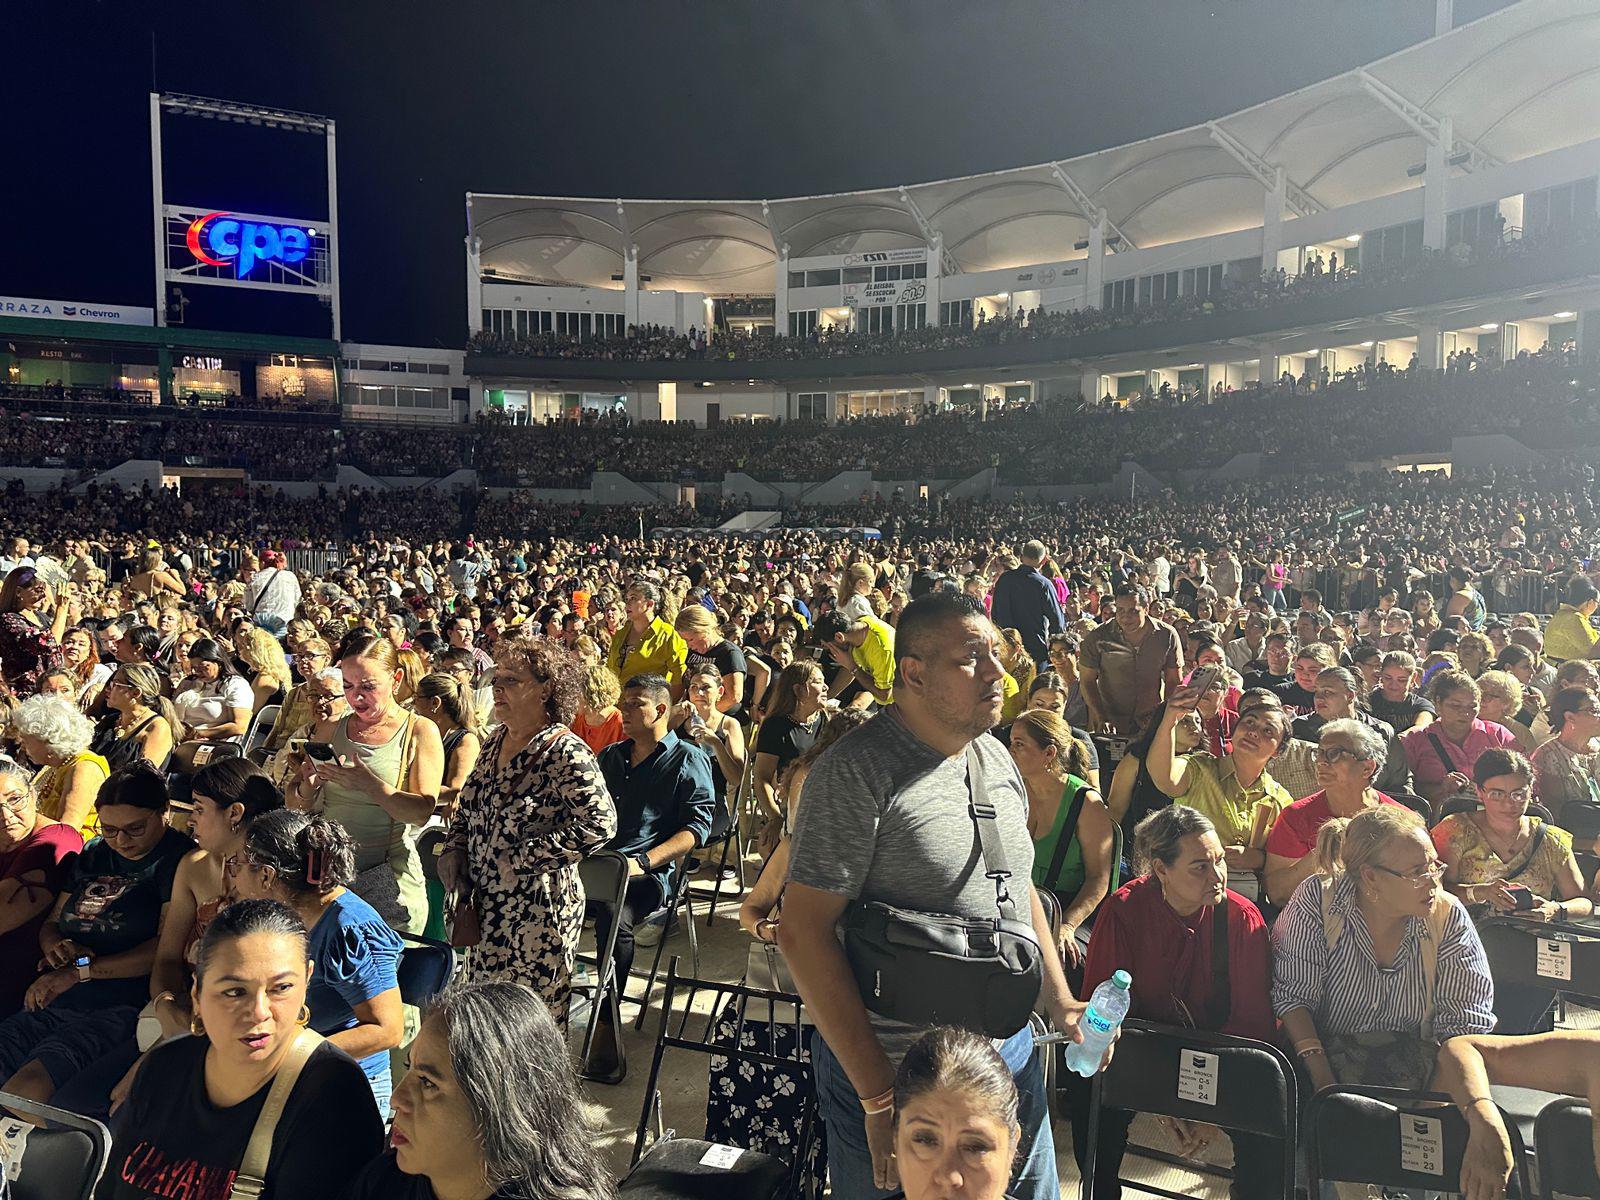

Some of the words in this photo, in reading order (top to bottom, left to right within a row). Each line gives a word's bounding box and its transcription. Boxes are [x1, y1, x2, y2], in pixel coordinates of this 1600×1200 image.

[208, 220, 309, 279] cpe
[873, 282, 895, 290] BEISBOL
[872, 289, 896, 297] ESCUCHA
[901, 285, 926, 303] 90.9
[80, 308, 120, 318] Chevron
[1093, 1017, 1111, 1031] ciel
[1199, 1077, 1210, 1085] C-5
[1198, 1092, 1208, 1100] 24
[1423, 1161, 1434, 1170] 23
